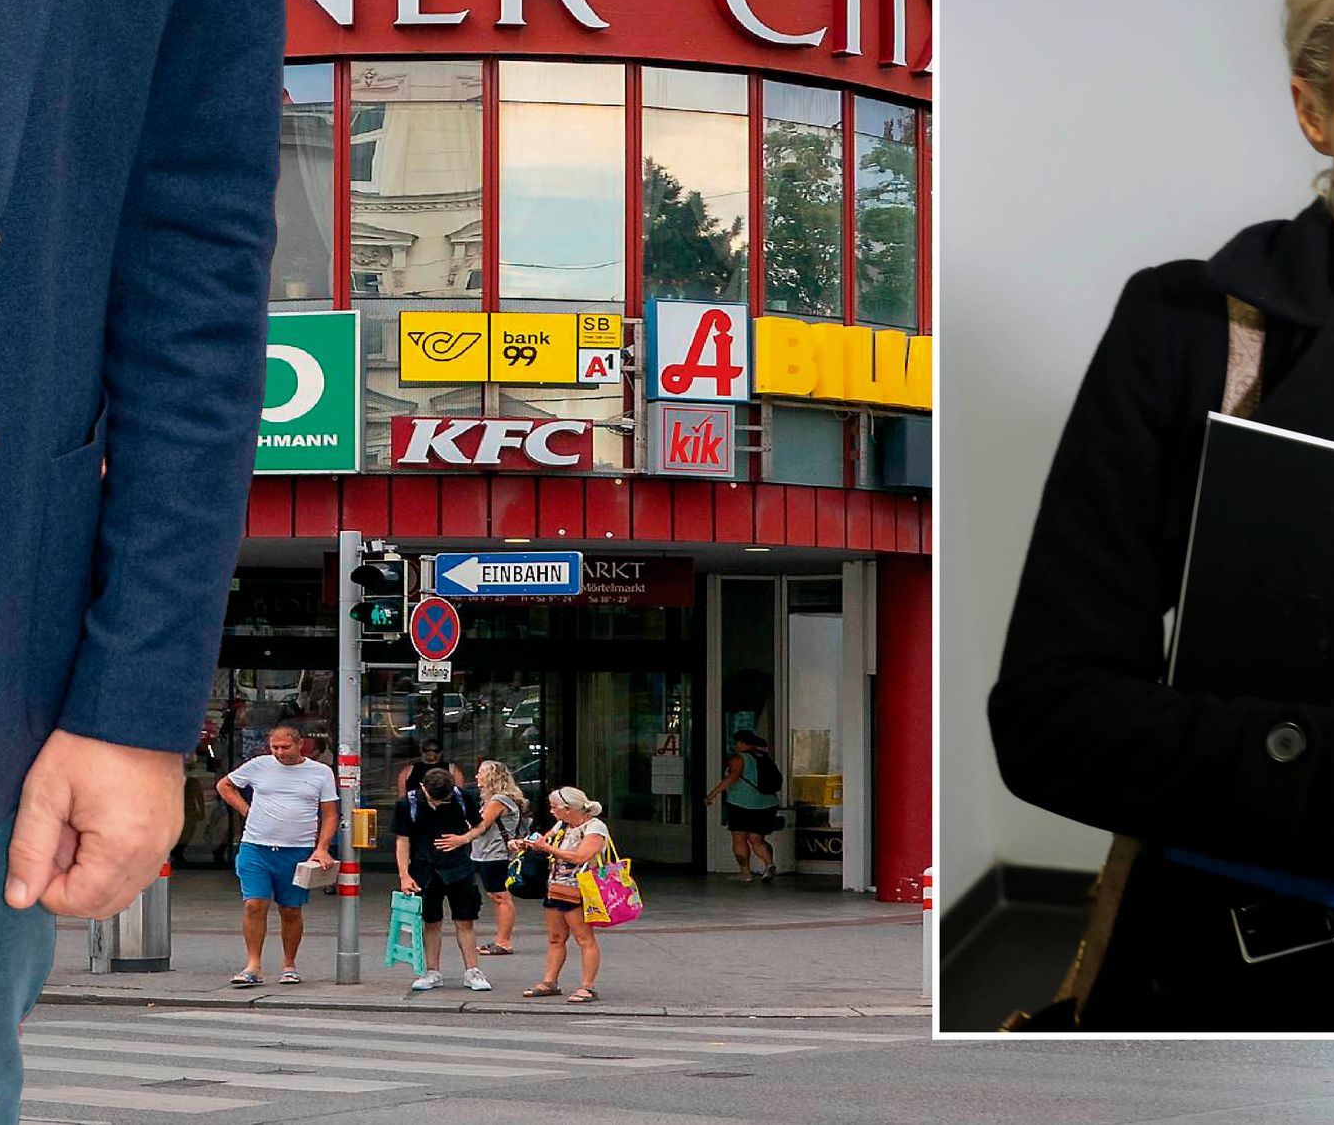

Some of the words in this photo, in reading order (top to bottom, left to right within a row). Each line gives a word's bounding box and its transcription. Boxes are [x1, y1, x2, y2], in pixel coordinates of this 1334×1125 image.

[583, 317, 610, 331] SB
[503, 331, 550, 345] bank
[503, 346, 537, 366] 99
[585, 354, 614, 377] A1
[397, 419, 588, 466] KFC
[669, 416, 724, 464] kik
[482, 565, 562, 583] EINBAHN
